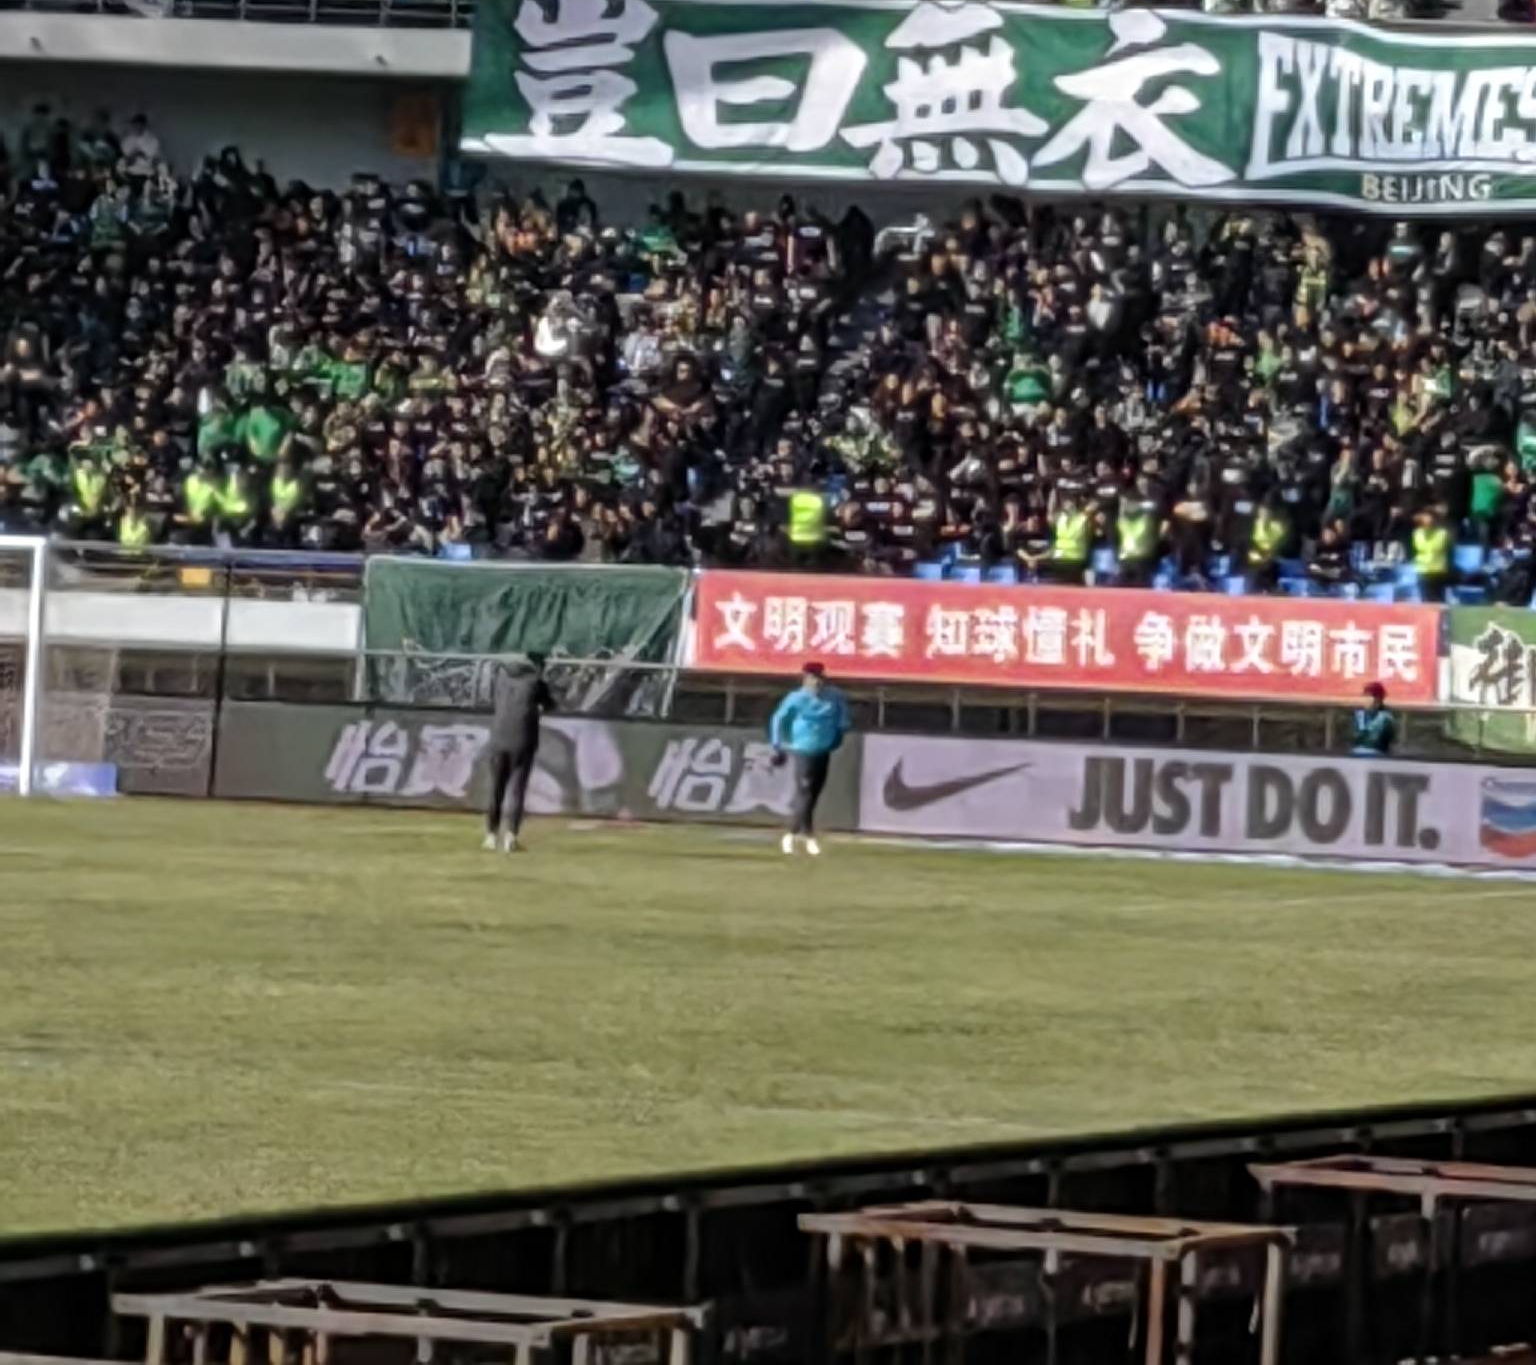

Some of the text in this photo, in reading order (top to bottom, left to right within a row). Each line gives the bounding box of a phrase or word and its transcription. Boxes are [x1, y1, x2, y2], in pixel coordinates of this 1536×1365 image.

[1361, 172, 1493, 201] BEIJING
[714, 591, 1420, 682] 文明观赛 知球懂礼 争做文明市民
[1068, 756, 1440, 851] JUST DO IT.
